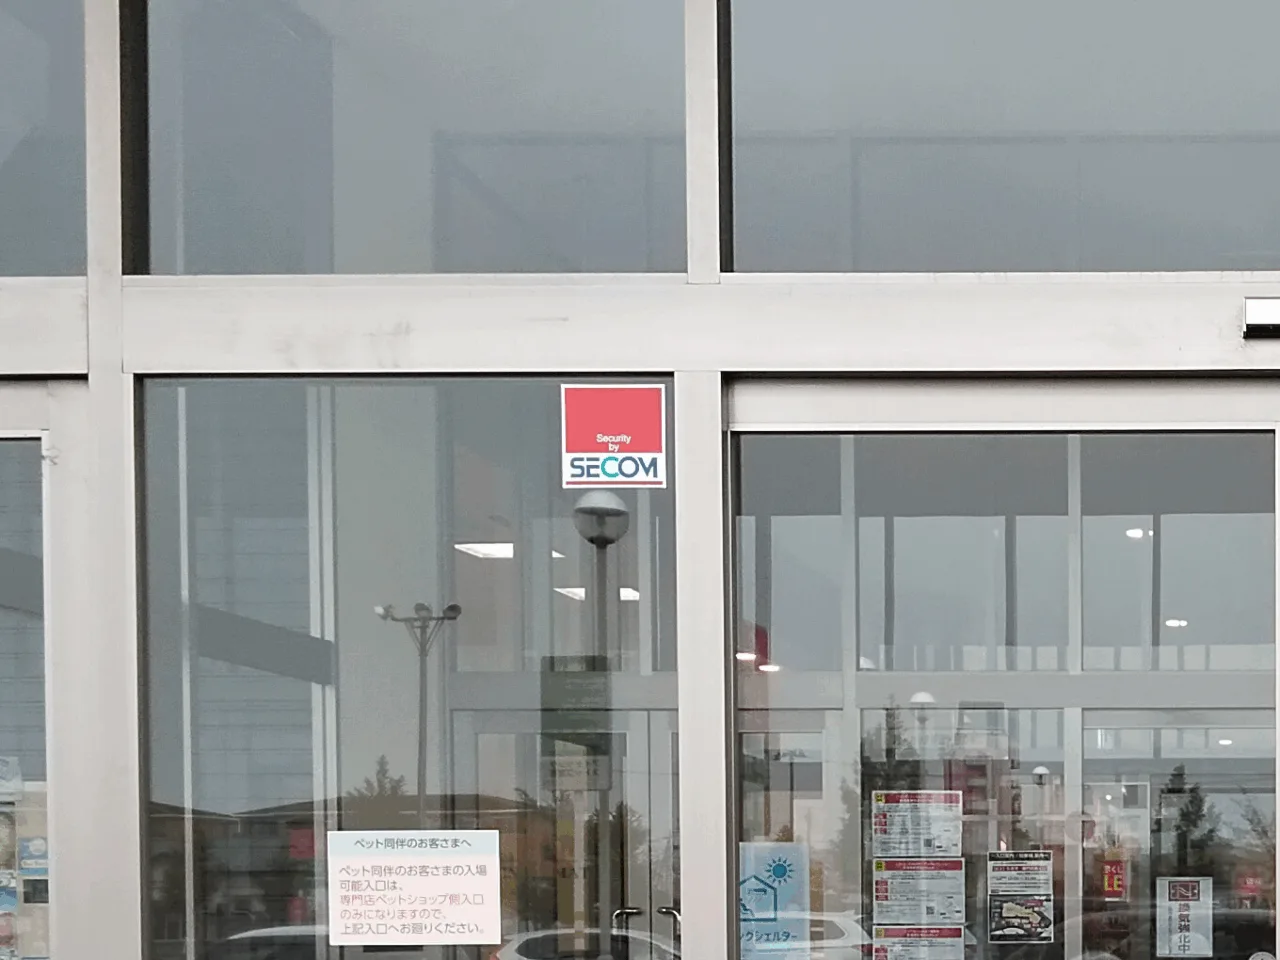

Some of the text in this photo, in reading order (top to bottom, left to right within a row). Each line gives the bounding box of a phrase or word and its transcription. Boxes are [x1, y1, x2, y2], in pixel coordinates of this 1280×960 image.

[596, 433, 631, 444] Security
[608, 442, 619, 452] by
[570, 456, 658, 478] SECOM
[354, 837, 472, 849] ペット同伴のお客さまへ
[339, 865, 487, 877] ペット同伴のお客さまの入場
[339, 879, 403, 892] 可能入口は、
[340, 894, 484, 906] 専門店ペットショップ側入口
[340, 909, 447, 920] のみになりますので、
[340, 923, 484, 935] 上記入口へお廻りください。
[1178, 903, 1190, 954] 換気強化中
